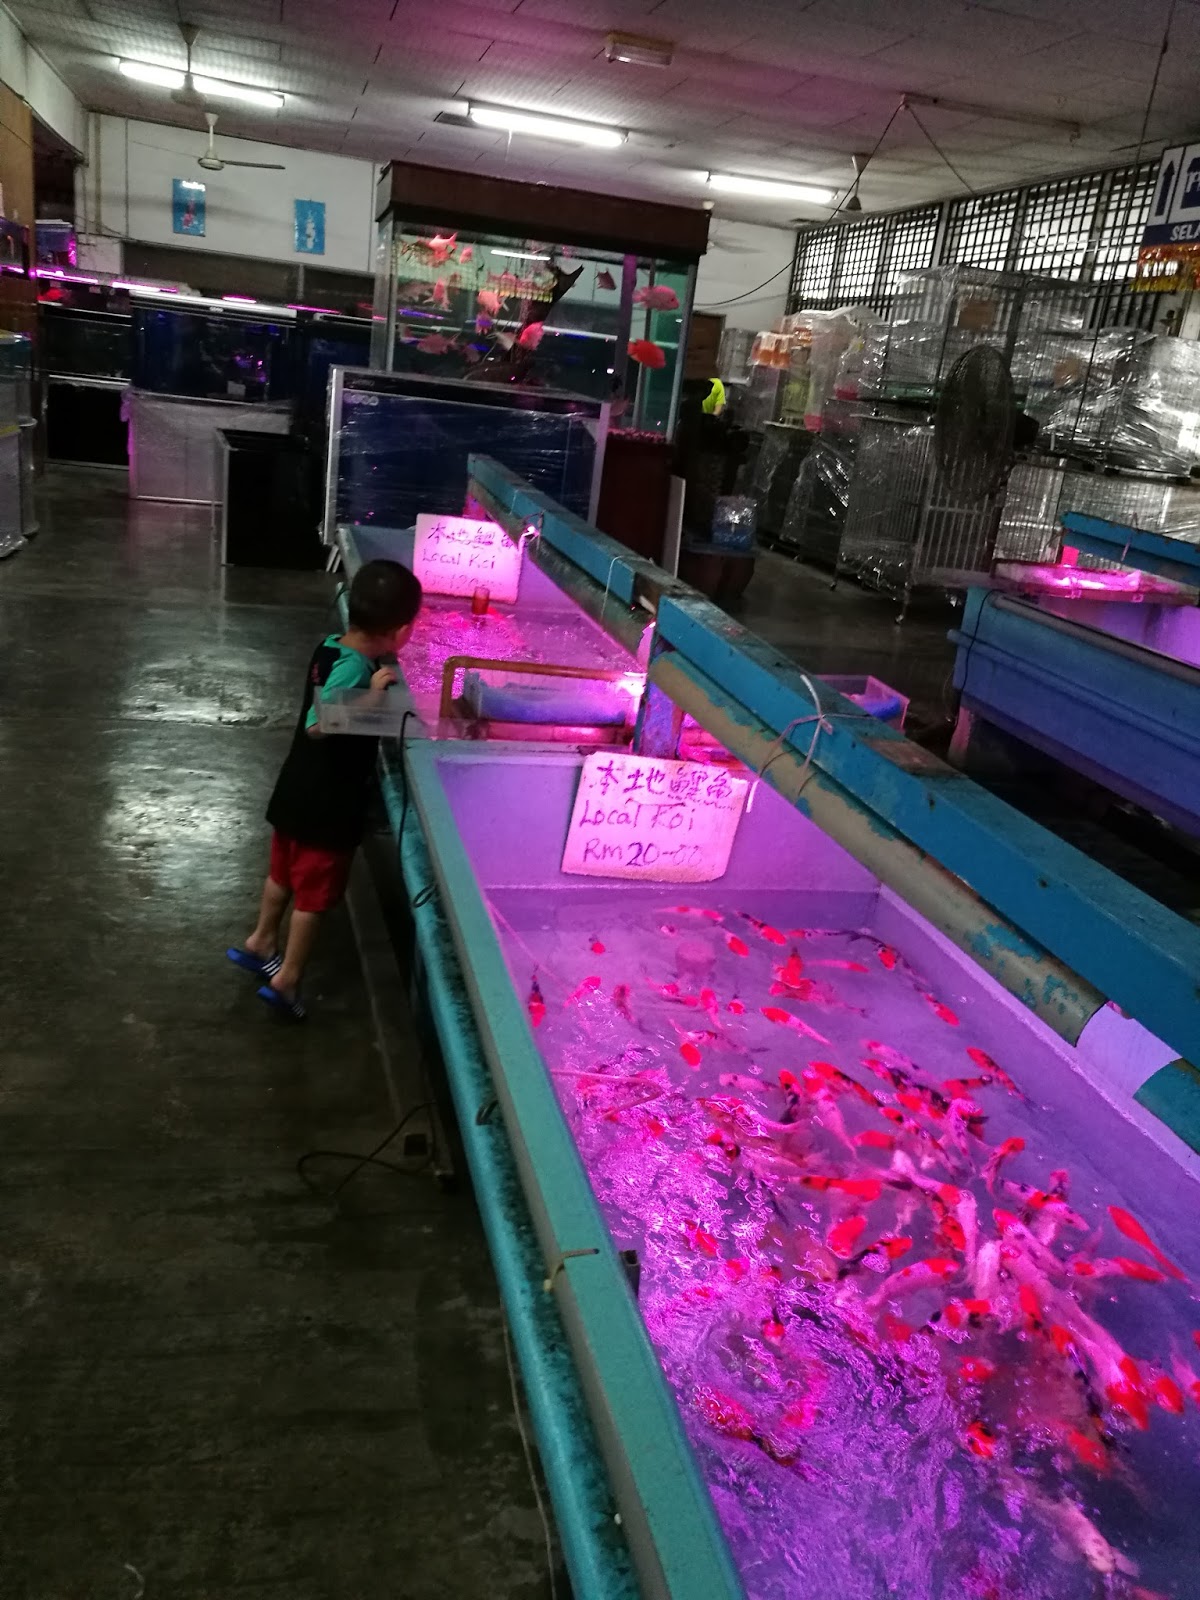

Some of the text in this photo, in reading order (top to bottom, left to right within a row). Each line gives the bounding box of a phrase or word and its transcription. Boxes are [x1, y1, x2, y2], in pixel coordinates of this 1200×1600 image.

[422, 549, 461, 565] Local
[579, 799, 697, 831] Local Koi
